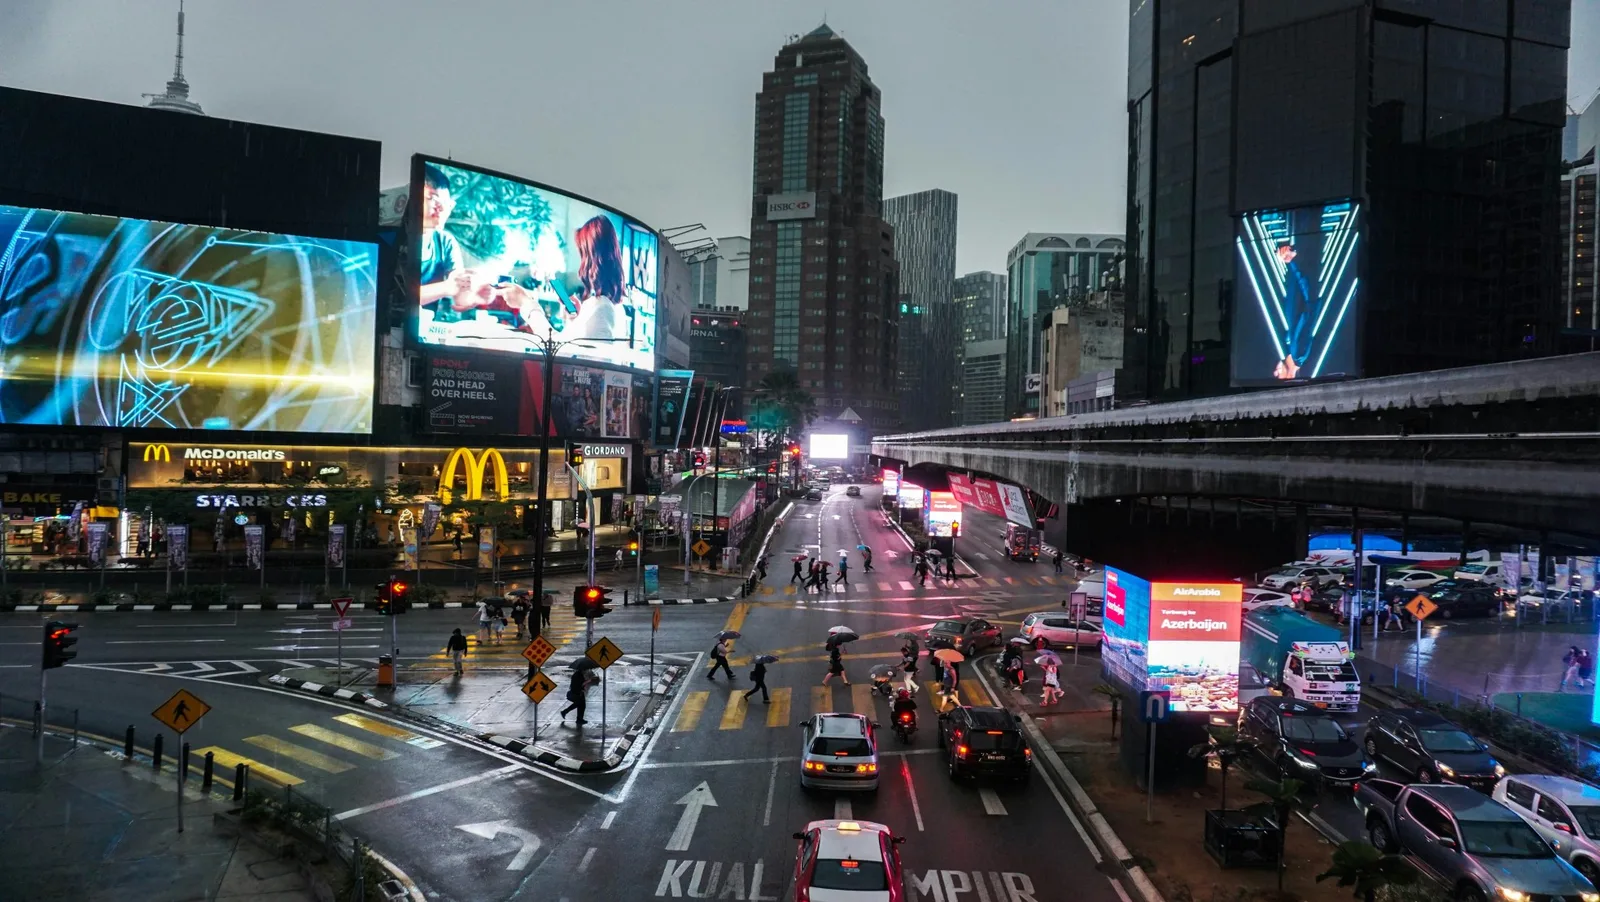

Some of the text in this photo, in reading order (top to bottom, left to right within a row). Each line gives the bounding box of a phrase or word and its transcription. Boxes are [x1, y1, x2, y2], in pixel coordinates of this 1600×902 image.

[770, 202, 796, 213] HSBC
[432, 368, 495, 381] FOR CHOICE
[432, 379, 486, 390] AND HEAD
[431, 389, 496, 400] OVER HEELS.
[184, 448, 286, 460] McDonald's
[584, 445, 626, 456] GIORDANO
[3, 492, 62, 503] BAKE
[196, 494, 327, 508] STARBUCKS
[1173, 587, 1221, 596] AirArabia
[1161, 618, 1227, 631] Azerbaijan
[654, 858, 1038, 902] KUAL MPUR
